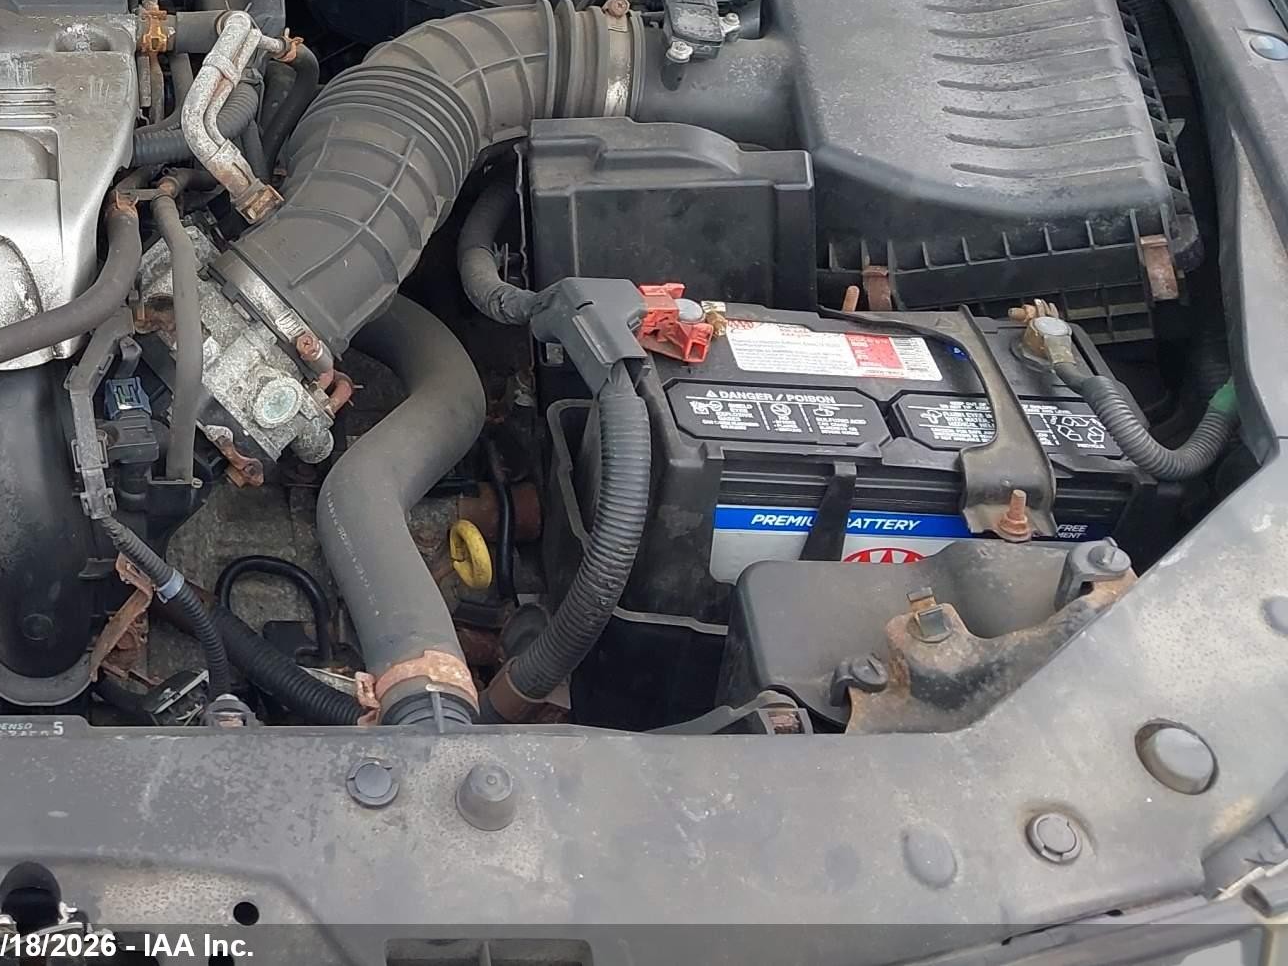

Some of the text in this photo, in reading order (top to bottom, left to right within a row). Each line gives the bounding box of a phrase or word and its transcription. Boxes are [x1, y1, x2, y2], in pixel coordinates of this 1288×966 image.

[718, 390, 773, 402] DANGER
[786, 393, 836, 404] POISON
[751, 514, 814, 527] PREMIU
[1056, 524, 1088, 533] FREE
[53, 721, 64, 735] 5
